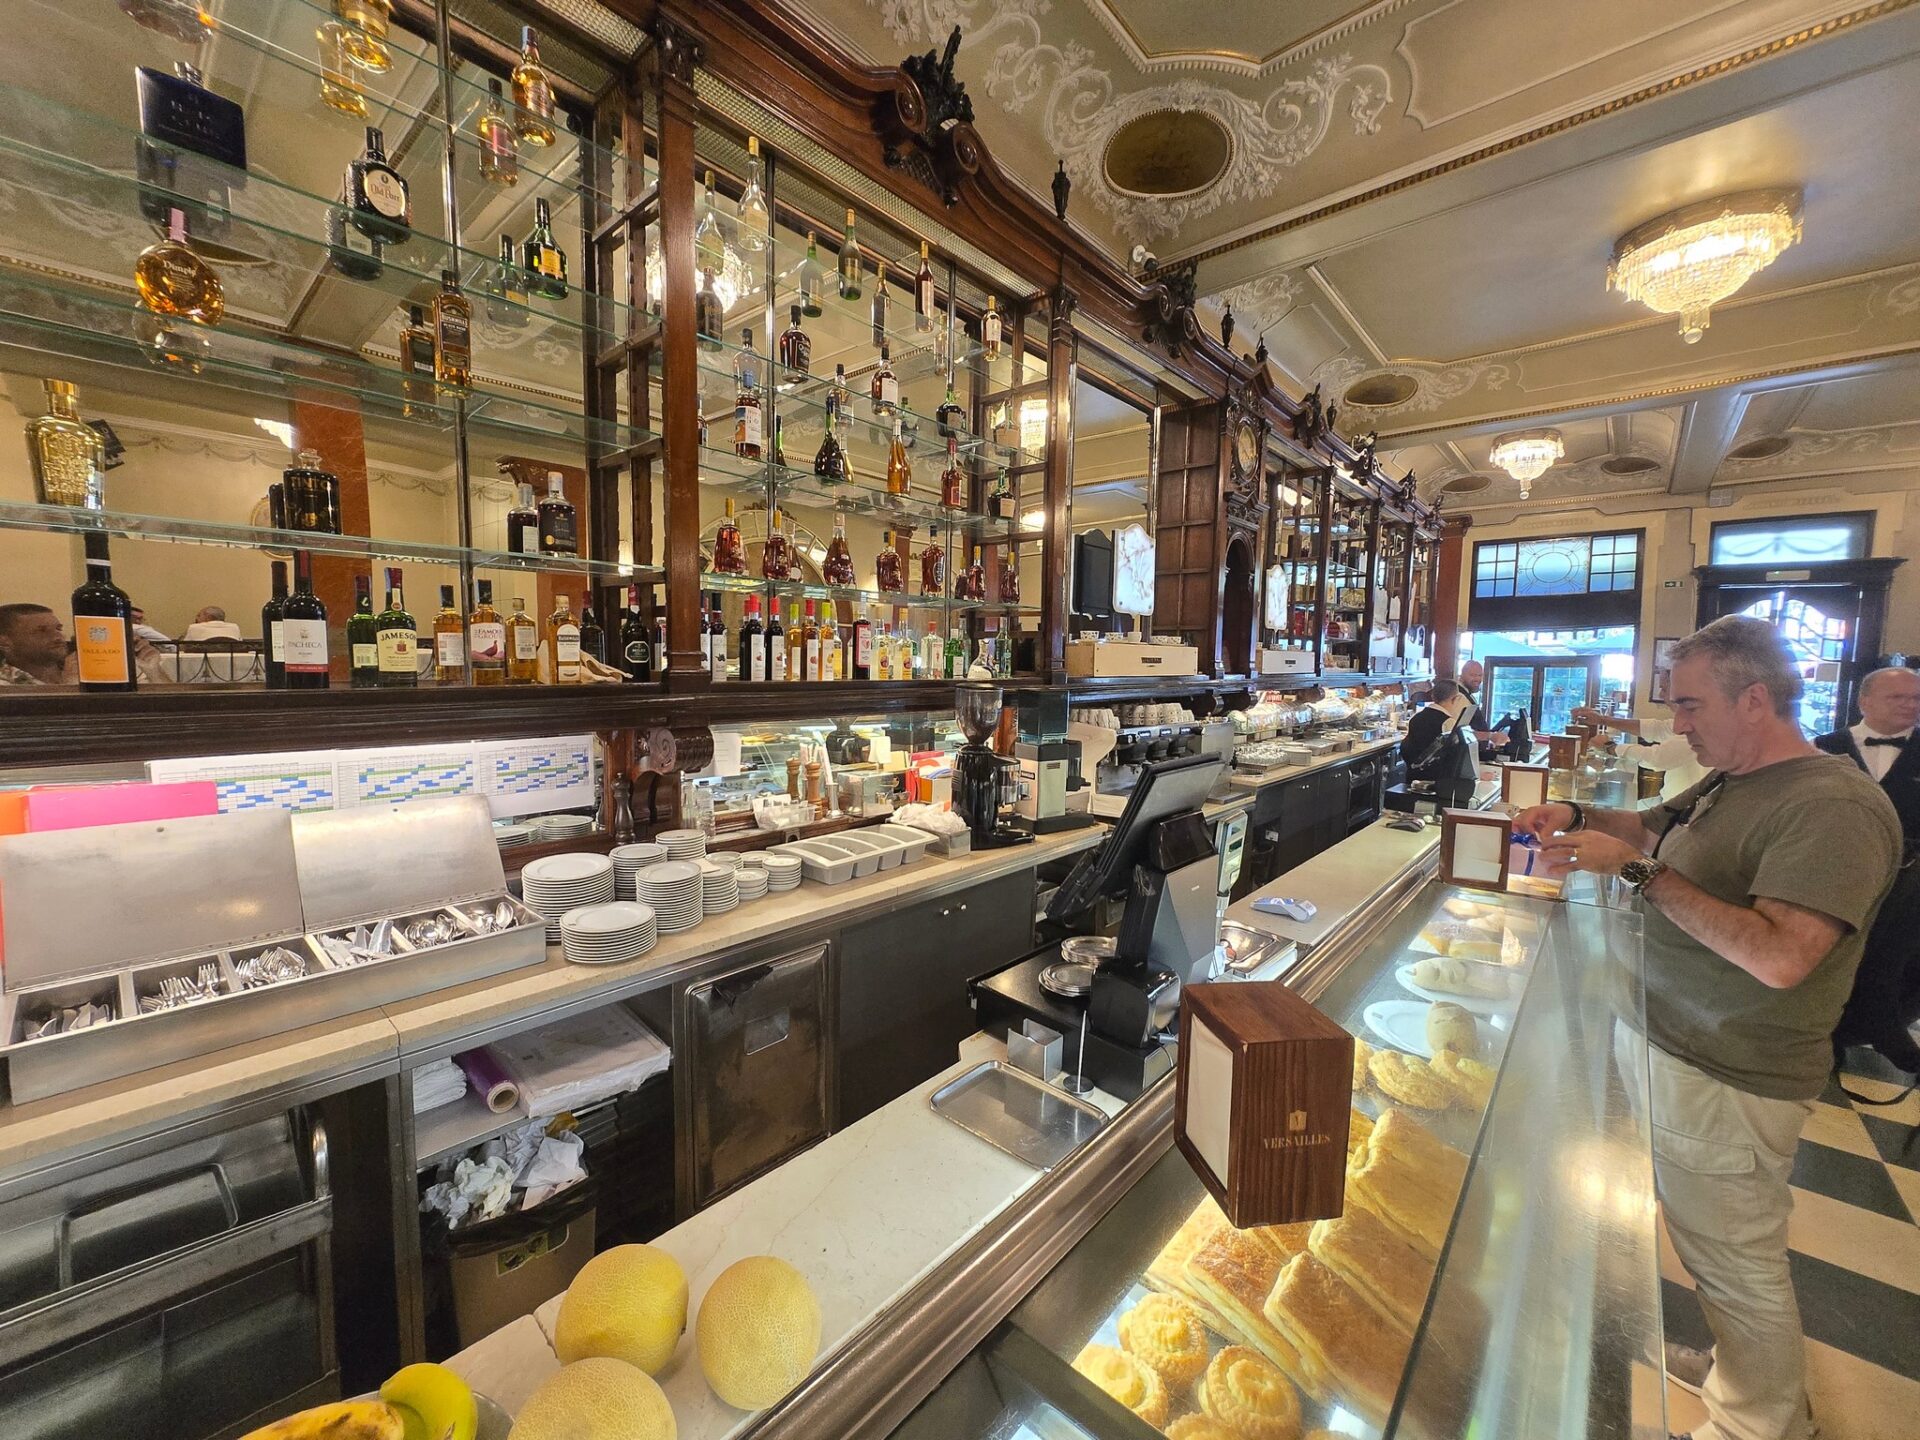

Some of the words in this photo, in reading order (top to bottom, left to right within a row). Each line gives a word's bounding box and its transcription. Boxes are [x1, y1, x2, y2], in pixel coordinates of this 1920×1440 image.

[370, 183, 385, 196] Old
[385, 189, 400, 202] Parr
[162, 259, 198, 277] Dimple
[287, 641, 323, 649] PACHECA
[1263, 1134, 1331, 1150] VERSAILLES
